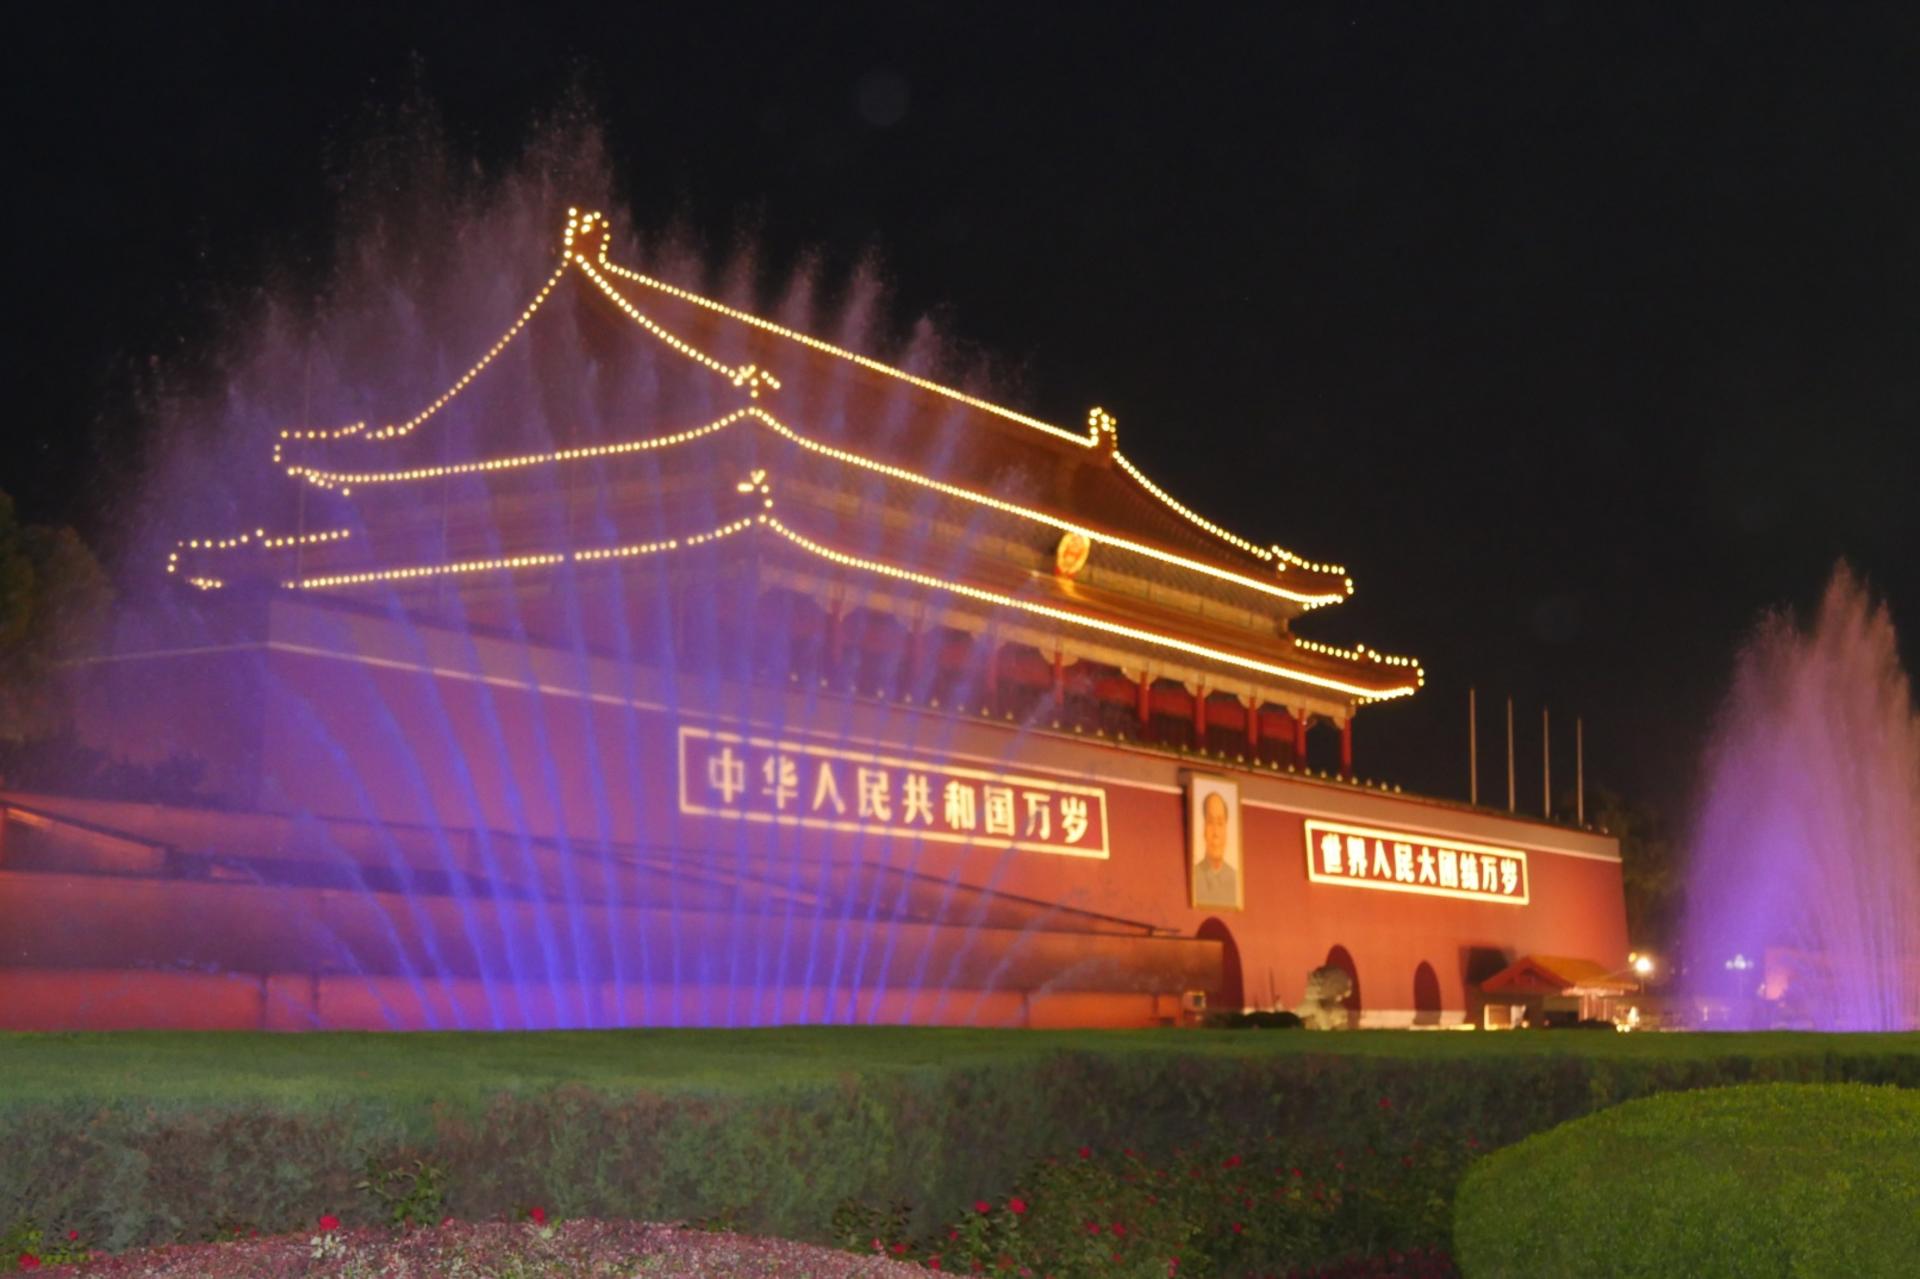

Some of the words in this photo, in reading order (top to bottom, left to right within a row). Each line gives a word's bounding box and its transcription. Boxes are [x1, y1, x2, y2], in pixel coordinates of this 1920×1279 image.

[708, 747, 1089, 843] 中华人民共和国万岁
